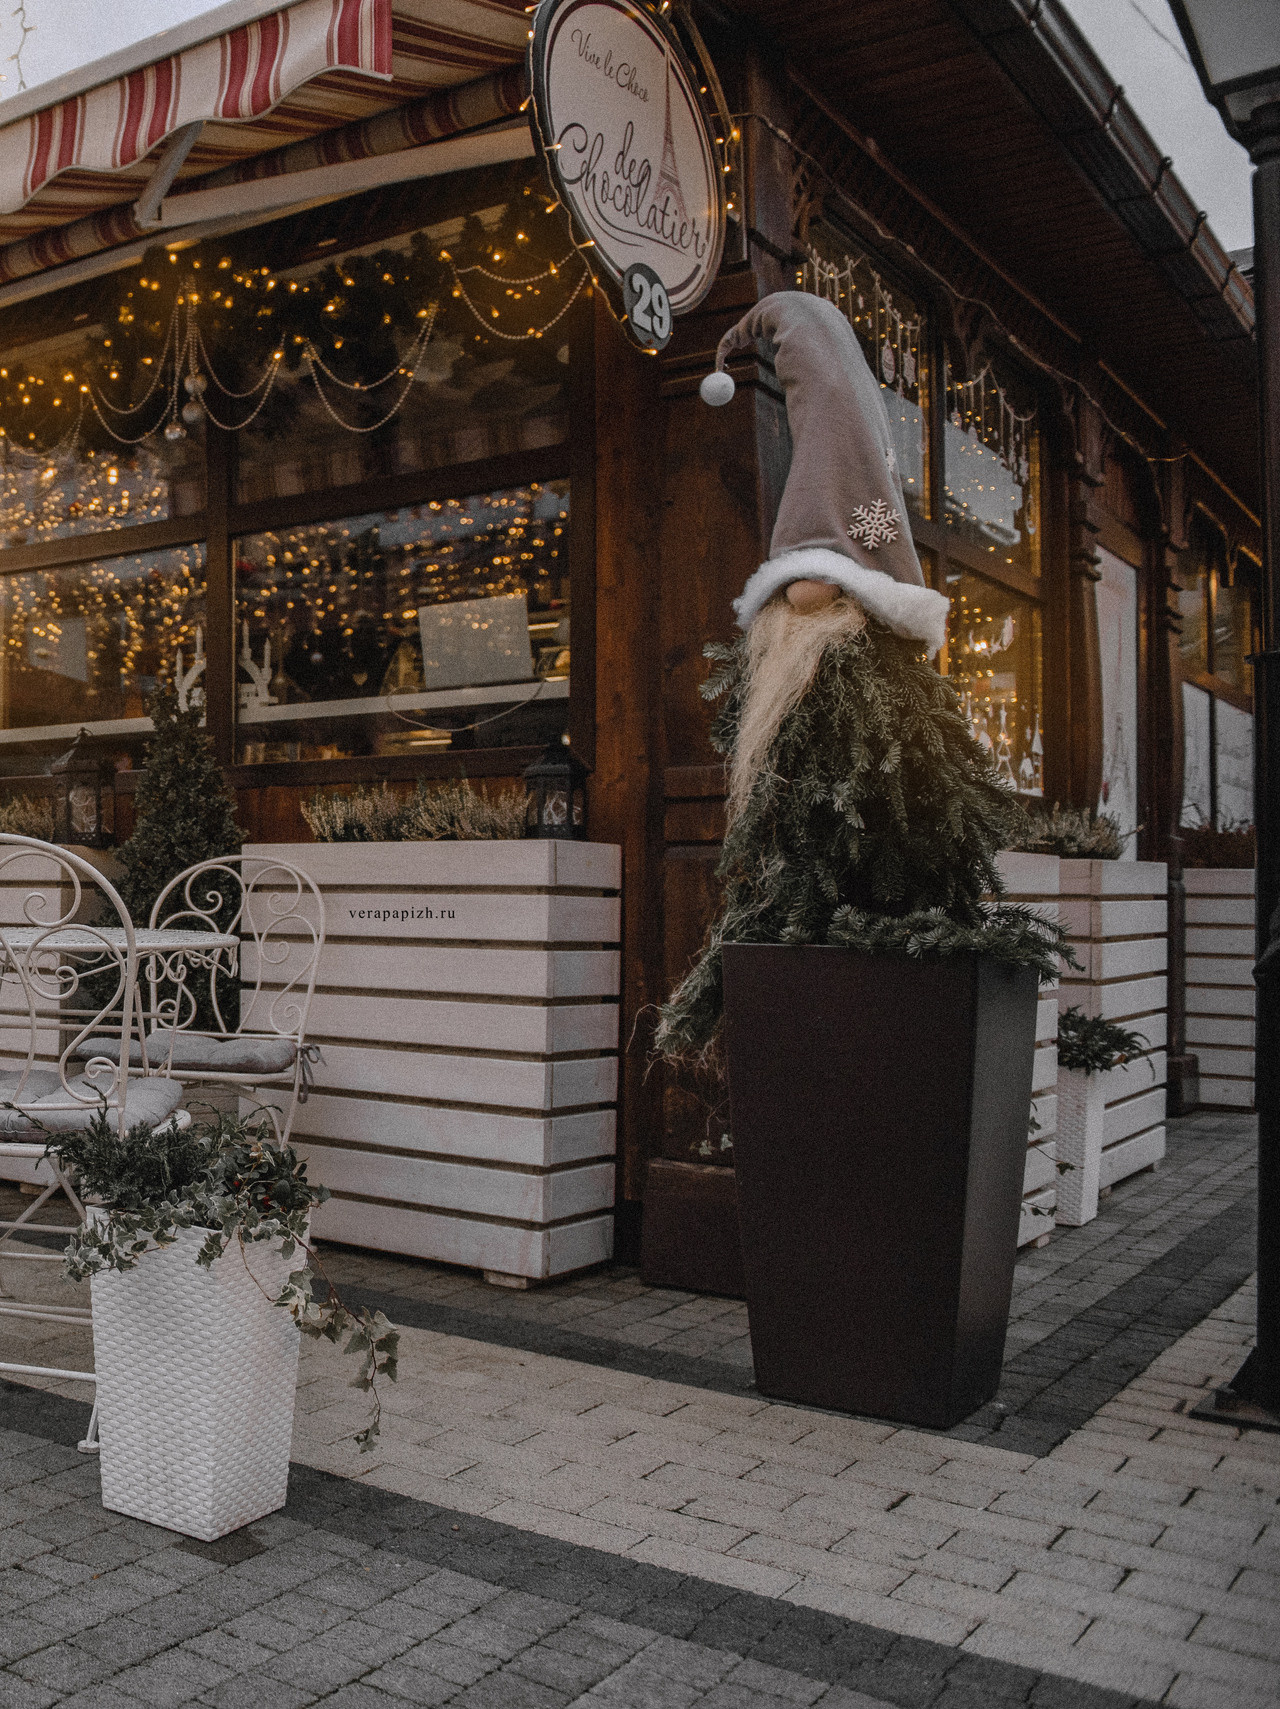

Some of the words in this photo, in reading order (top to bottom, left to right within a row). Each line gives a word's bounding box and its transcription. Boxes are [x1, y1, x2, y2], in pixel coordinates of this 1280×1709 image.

[570, 28, 602, 69] Vive
[604, 49, 615, 79] le
[557, 122, 706, 258] Chocolatier
[632, 272, 671, 339] 29
